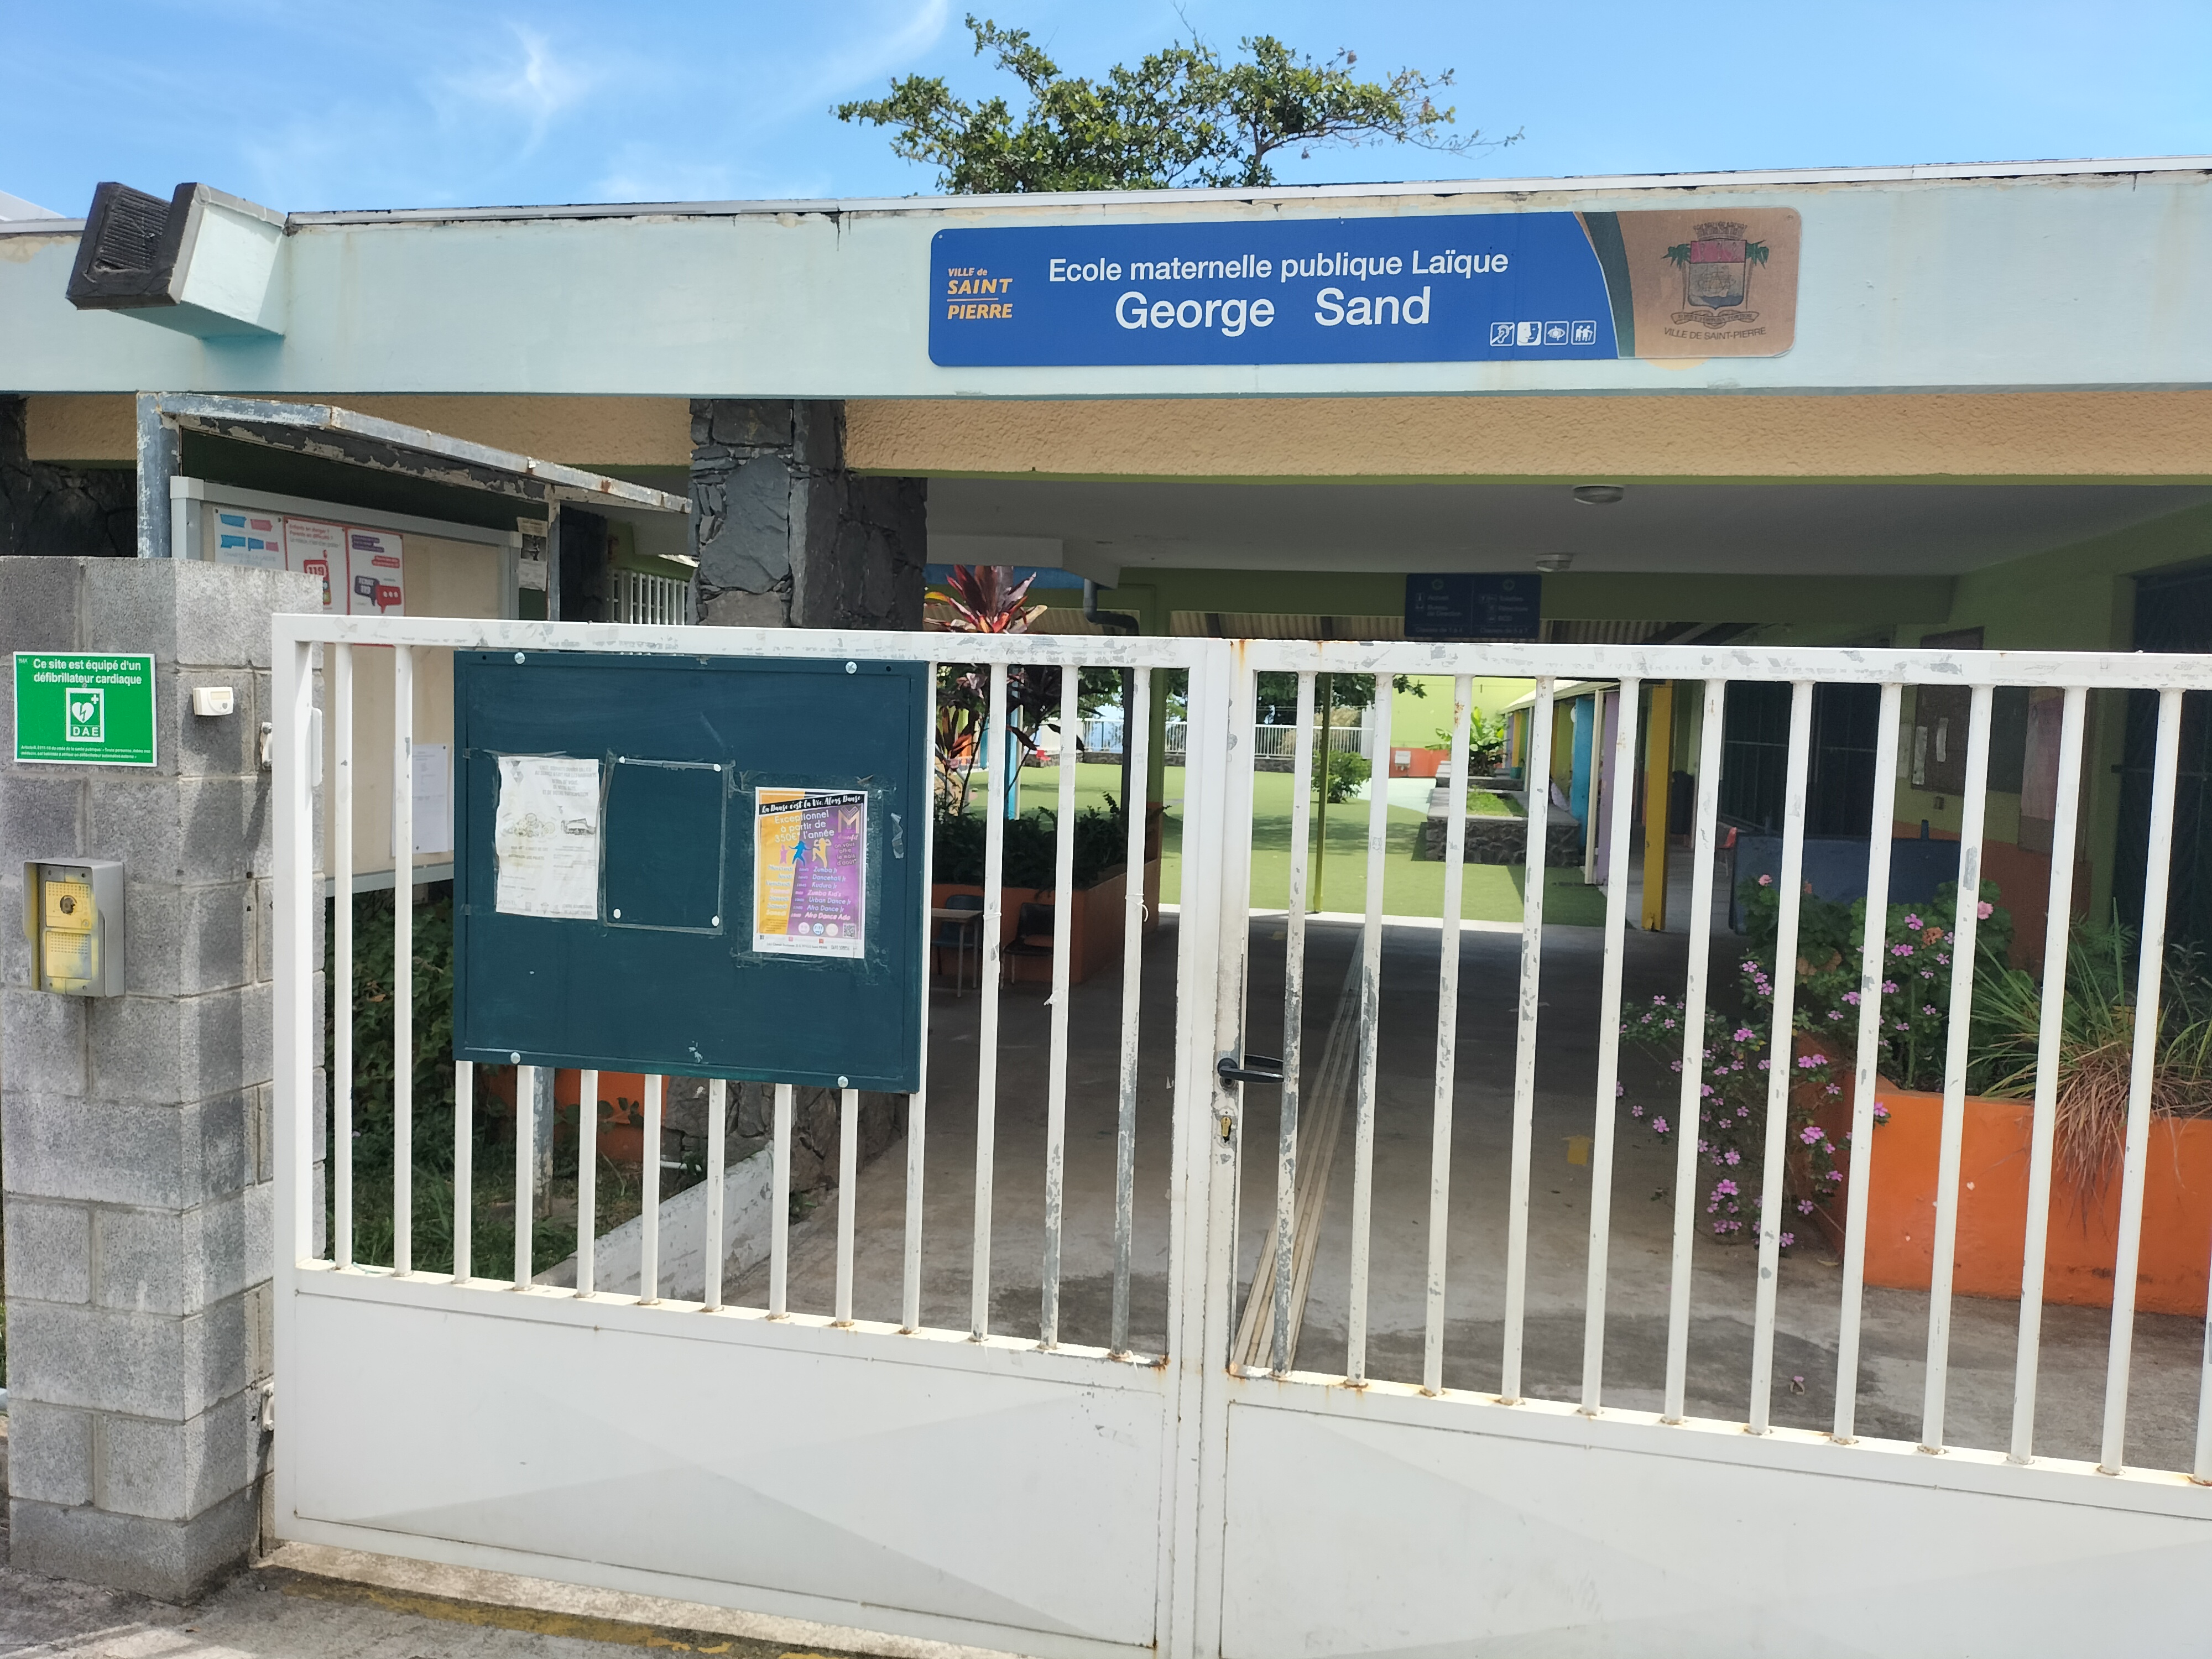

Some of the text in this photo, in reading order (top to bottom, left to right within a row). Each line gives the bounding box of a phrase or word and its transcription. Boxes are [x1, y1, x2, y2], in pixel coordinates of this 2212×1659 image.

[948, 267, 988, 277] VILLE de
[1049, 249, 1510, 283] Ecole maternelle publique Laïque
[947, 278, 1013, 295] SAINT
[947, 303, 1014, 320] PIERRE
[1115, 286, 1431, 337] George Sand
[1664, 327, 1688, 338] VILLE
[1704, 327, 1767, 340] SAINT-PIERRE
[33, 658, 46, 669] Ce
[49, 659, 67, 670] site
[69, 660, 84, 670] est
[86, 660, 118, 672] équipé
[120, 660, 142, 671] d'un
[33, 671, 142, 686] défibrillateur cardiaque
[770, 804, 787, 812] Danse
[842, 794, 861, 803] Danse
[775, 810, 830, 824] Exceptionnel
[789, 822, 812, 834] partir
[815, 820, 826, 828] de
[803, 830, 834, 839] l'année
